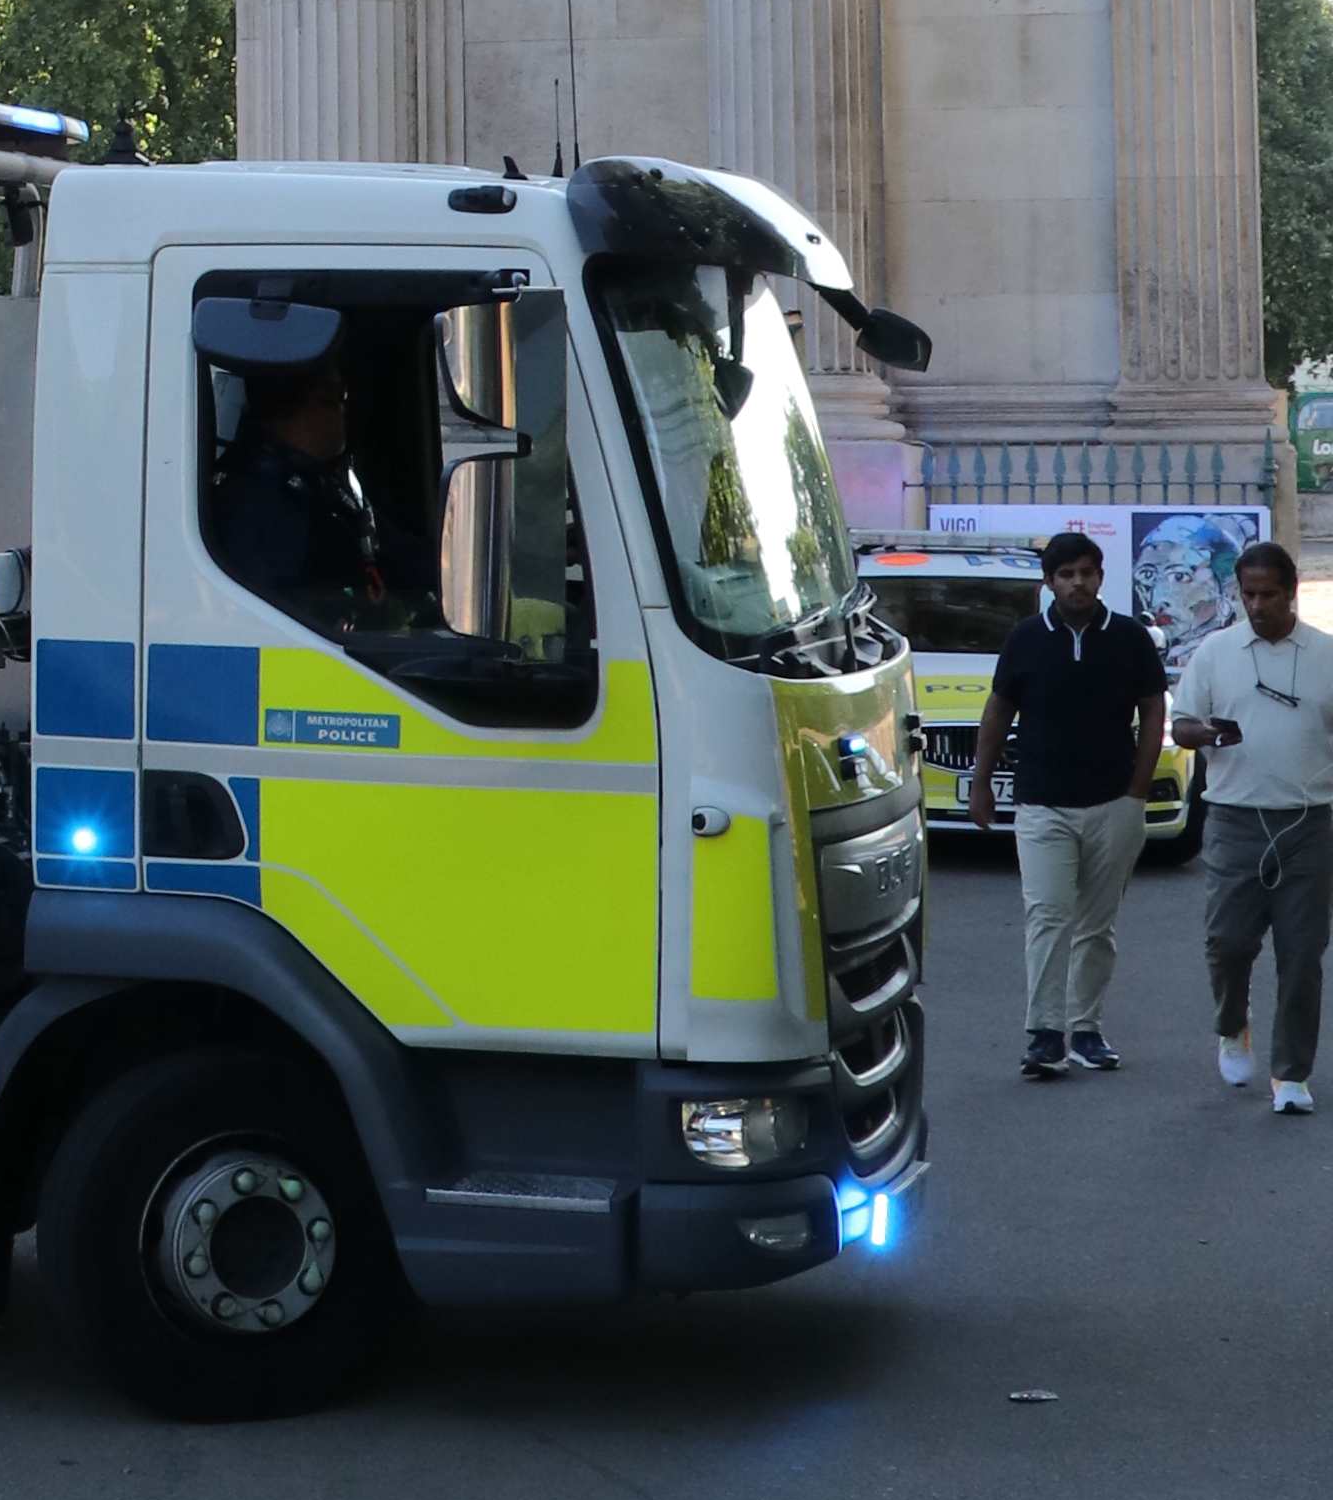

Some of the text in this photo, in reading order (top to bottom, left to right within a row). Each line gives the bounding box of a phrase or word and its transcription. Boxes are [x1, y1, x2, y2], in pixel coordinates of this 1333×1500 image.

[1312, 438, 1333, 456] Lo
[939, 517, 977, 533] VIGO
[306, 715, 390, 729] METROPOLITAN
[317, 729, 378, 743] POLICE
